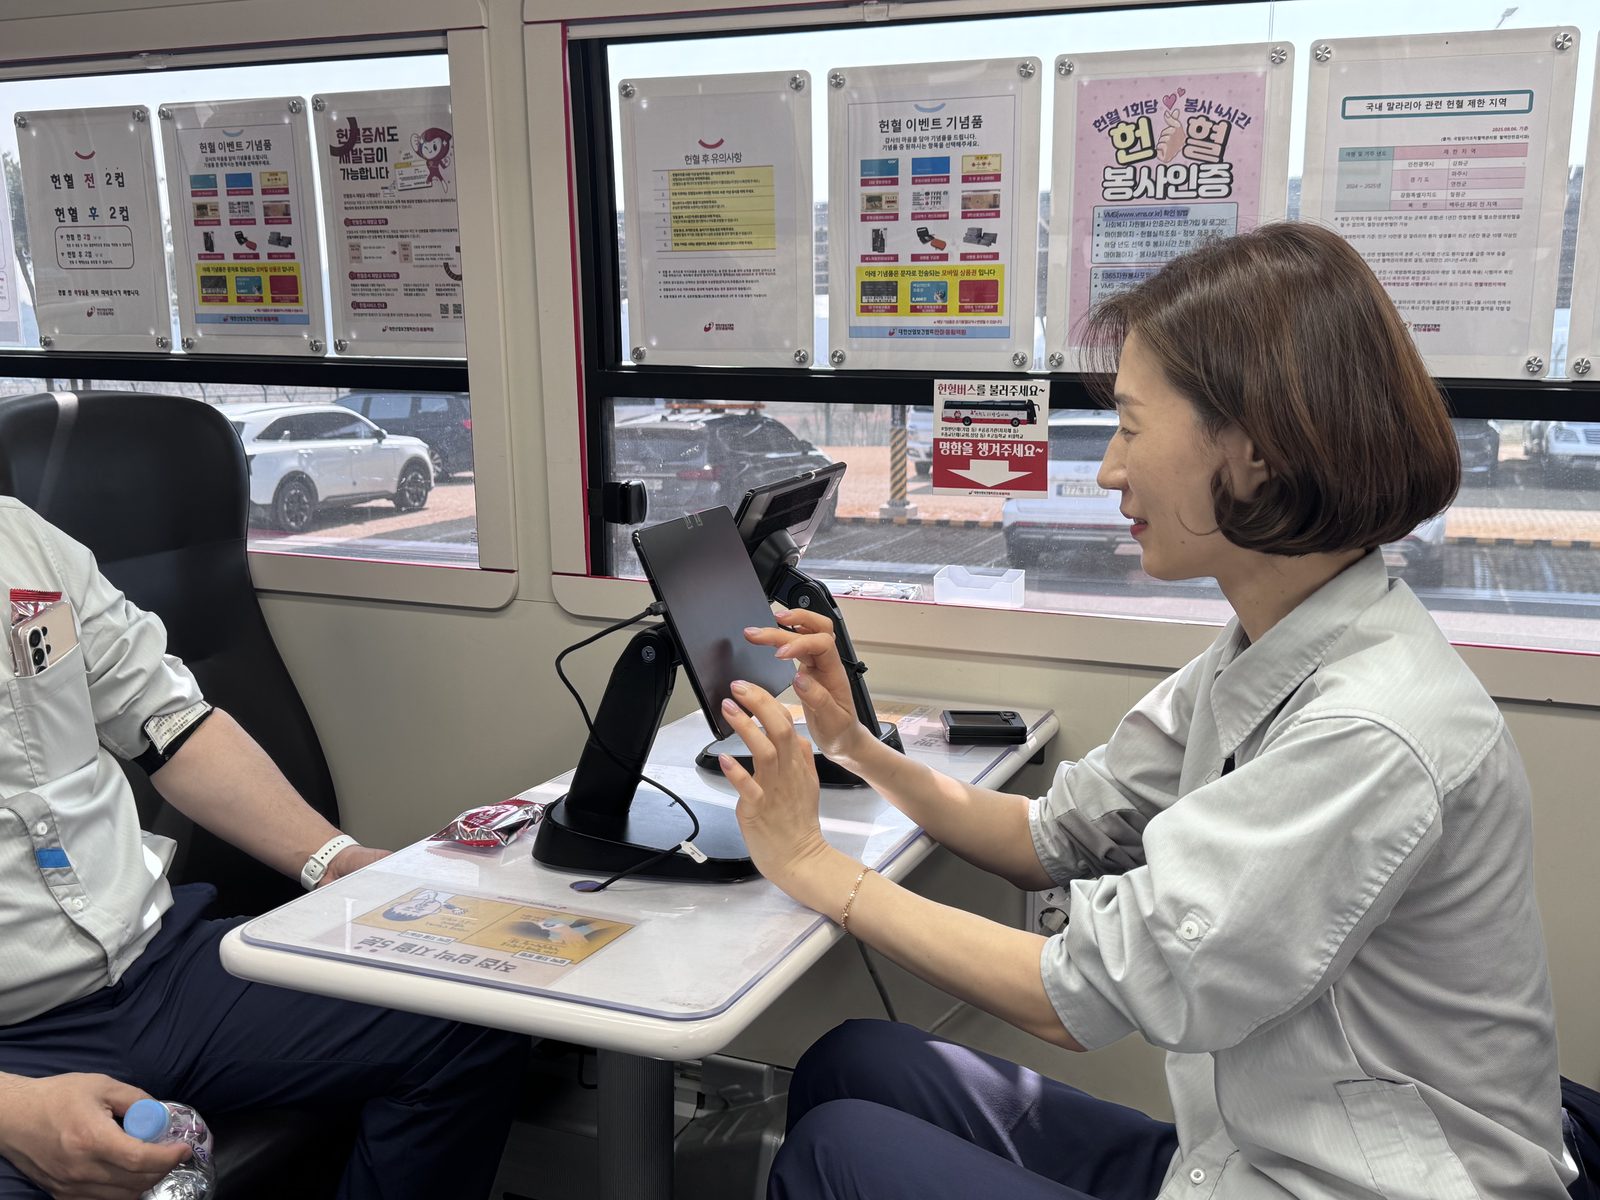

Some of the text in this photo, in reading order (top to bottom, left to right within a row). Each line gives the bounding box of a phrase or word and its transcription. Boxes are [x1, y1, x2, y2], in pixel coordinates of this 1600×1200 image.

[1366, 97, 1507, 112] 국내 말라리아 관련 헌혈 제한 지역
[1092, 98, 1252, 133] 헌혈 1회당 봉사 4시간
[879, 114, 983, 134] 헌혈 이벤트 기념품
[199, 139, 272, 154] 헌혈 이벤트 기념품
[1108, 114, 1232, 165] 헌 혈
[684, 152, 742, 166] 헌혈 후 유의사항
[50, 171, 125, 190] 헌혈 전 2컵
[340, 167, 389, 180] 가능합니다
[1102, 162, 1233, 201] 봉사인증
[54, 206, 129, 222] 헌혈 후 2컵
[937, 383, 1046, 397] 헌혈버스를 불러주세요~
[939, 441, 1044, 458] 명함을 챙겨주세요~
